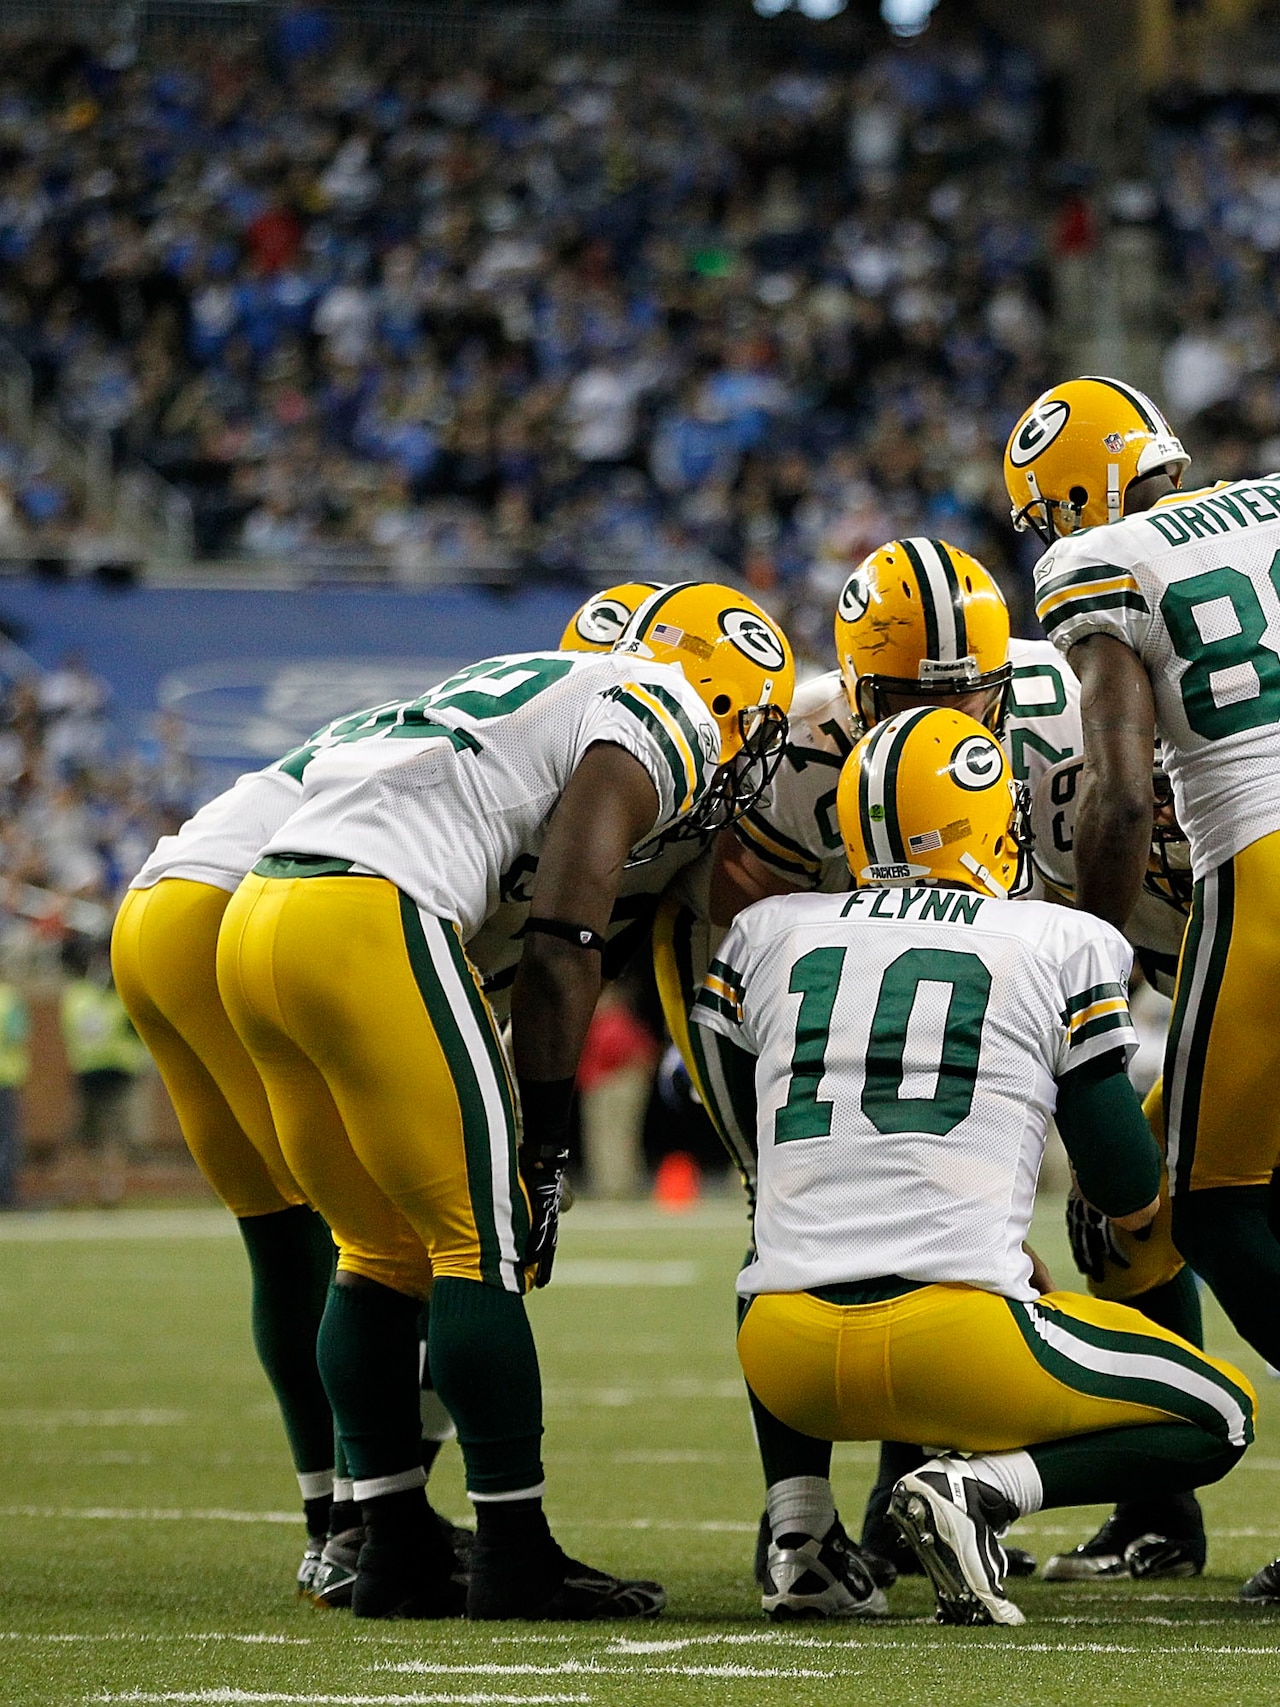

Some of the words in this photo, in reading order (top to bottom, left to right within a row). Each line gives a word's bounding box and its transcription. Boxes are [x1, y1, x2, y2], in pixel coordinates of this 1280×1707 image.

[869, 864, 911, 879] PACKERS
[839, 887, 985, 925] FLYNN
[774, 945, 993, 1145] 10
